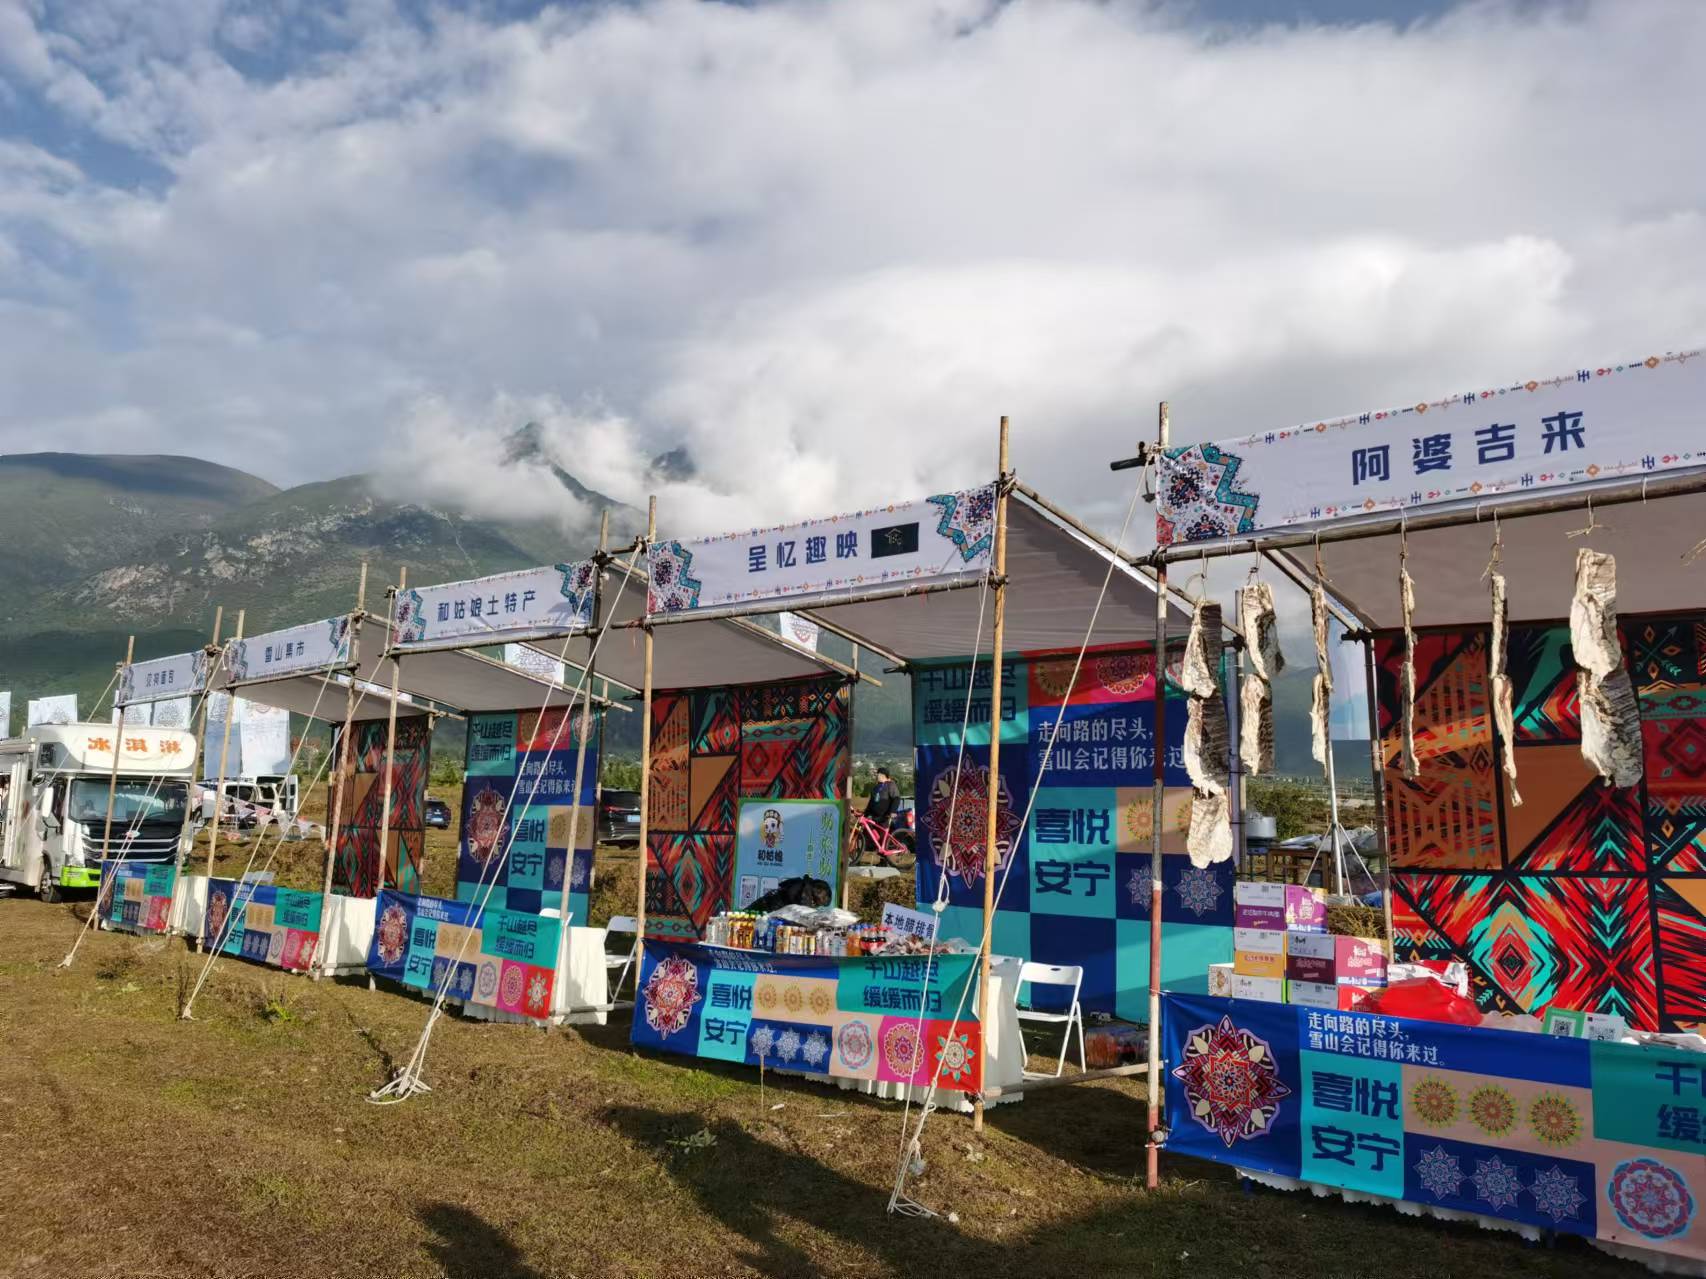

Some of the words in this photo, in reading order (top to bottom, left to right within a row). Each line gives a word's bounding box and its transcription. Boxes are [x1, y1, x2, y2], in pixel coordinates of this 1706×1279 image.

[1351, 410, 1586, 486] 阿婆吉来
[748, 530, 858, 573] 呈忆趣映
[437, 589, 537, 622] 和姑娘土特产
[922, 663, 1016, 692] 千山越尽
[87, 736, 182, 753] 冰淇淋
[514, 816, 545, 843] 喜悦
[1034, 807, 1110, 845] 喜悦
[510, 852, 543, 876] 安宁
[1034, 860, 1111, 897] 安宁
[414, 927, 437, 949] 喜悦
[884, 912, 935, 939] 本地腊排骨
[407, 954, 432, 975] 安宁
[864, 956, 940, 984] 千山越尽
[710, 982, 752, 1010] 喜悦
[863, 985, 942, 1013] 缓缓而归
[704, 1017, 748, 1045] 安宁
[1655, 1060, 1706, 1098] 千
[1311, 1070, 1400, 1121] 喜悦
[1656, 1103, 1706, 1146] 缓
[1311, 1125, 1401, 1172] 安宁
